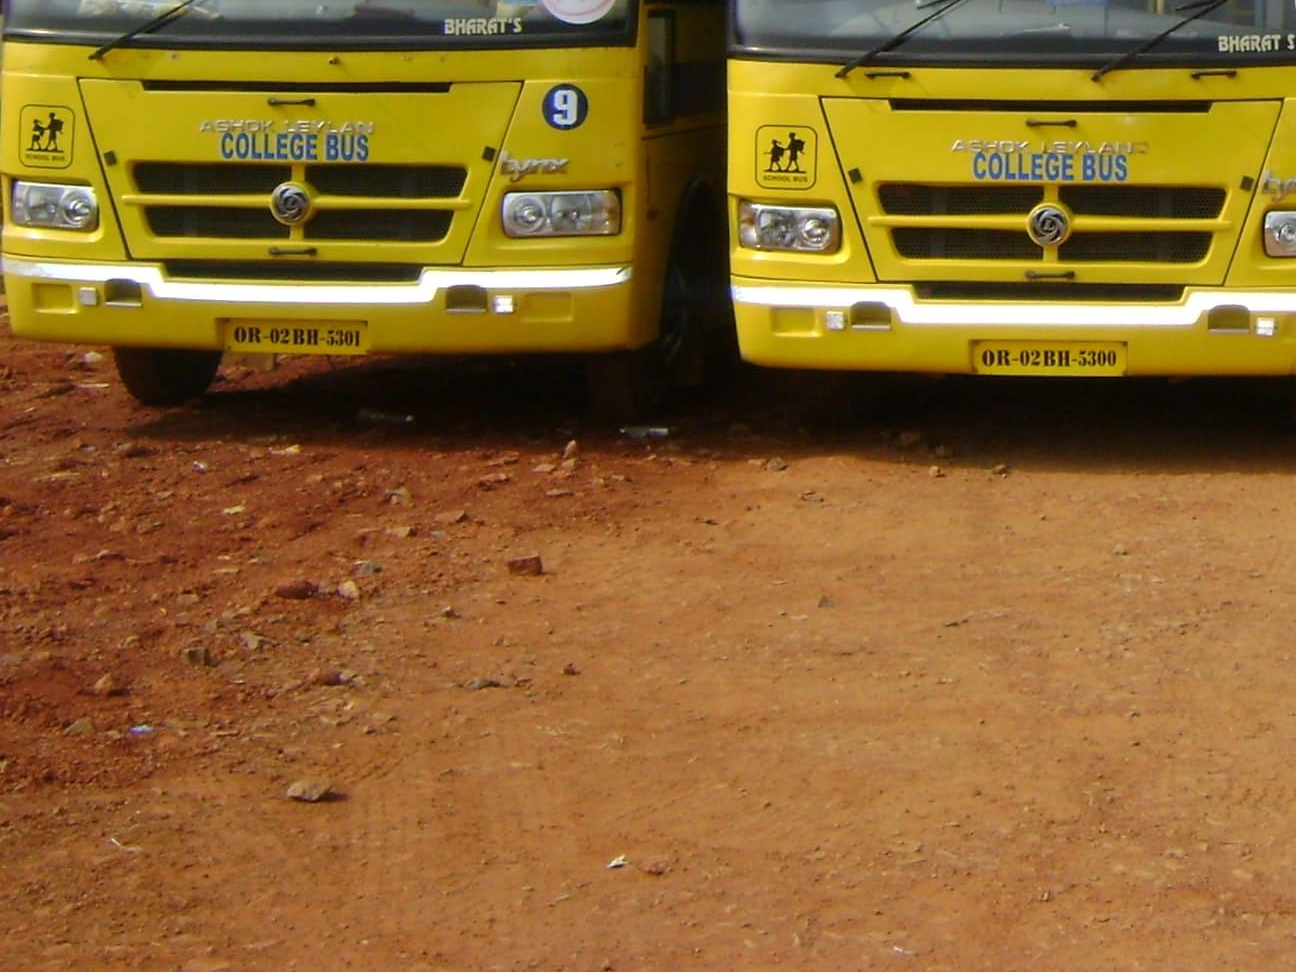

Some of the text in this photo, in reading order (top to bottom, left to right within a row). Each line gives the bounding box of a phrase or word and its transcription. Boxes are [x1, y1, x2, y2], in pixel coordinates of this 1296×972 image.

[444, 17, 522, 36] BHARAT'S
[553, 89, 578, 126] 9
[200, 119, 275, 133] ASHOK
[221, 132, 369, 162] COLLEGE BUS
[951, 139, 1149, 155] ASHOK LEYLAND
[973, 152, 1127, 181] COLLEGE BUS
